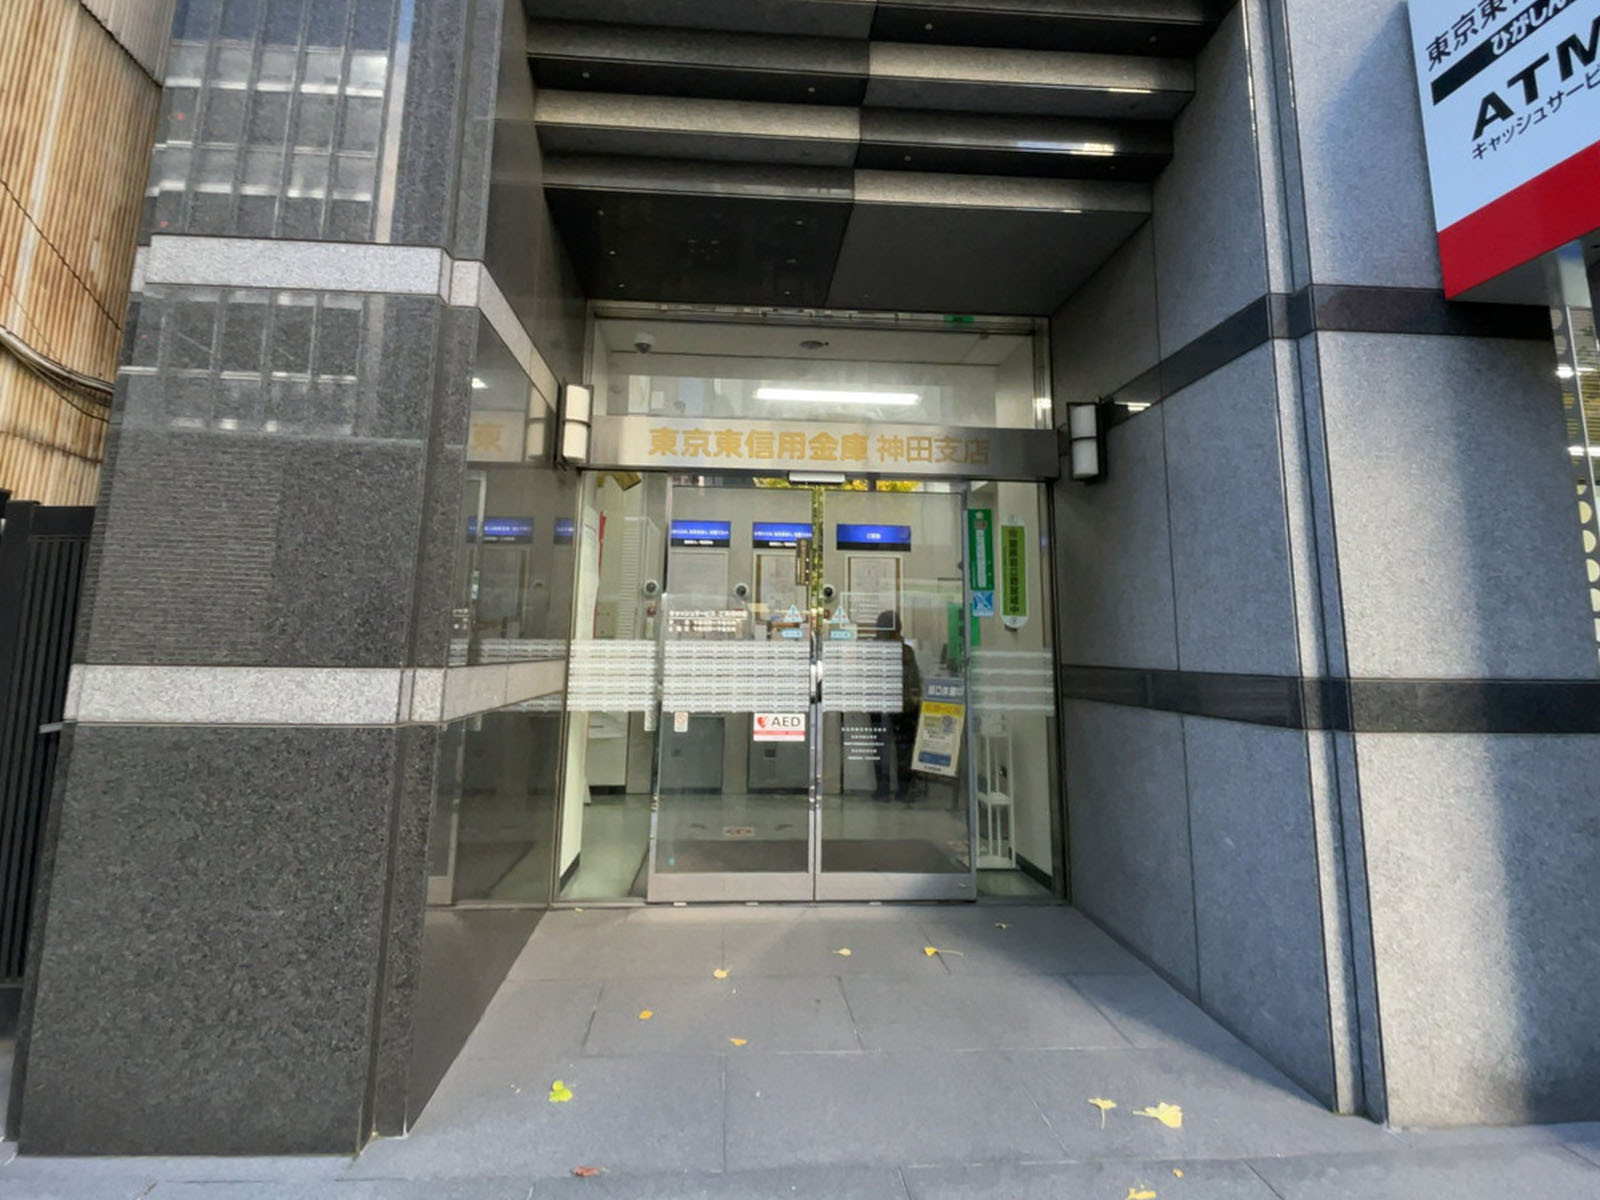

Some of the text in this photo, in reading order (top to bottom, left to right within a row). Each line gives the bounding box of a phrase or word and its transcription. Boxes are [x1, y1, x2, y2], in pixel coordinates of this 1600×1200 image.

[1425, 0, 1519, 72] 東京東
[1472, 15, 1600, 142] ATM
[649, 427, 990, 465] 東京東信用金庫 神田支店
[771, 716, 801, 727] AED
